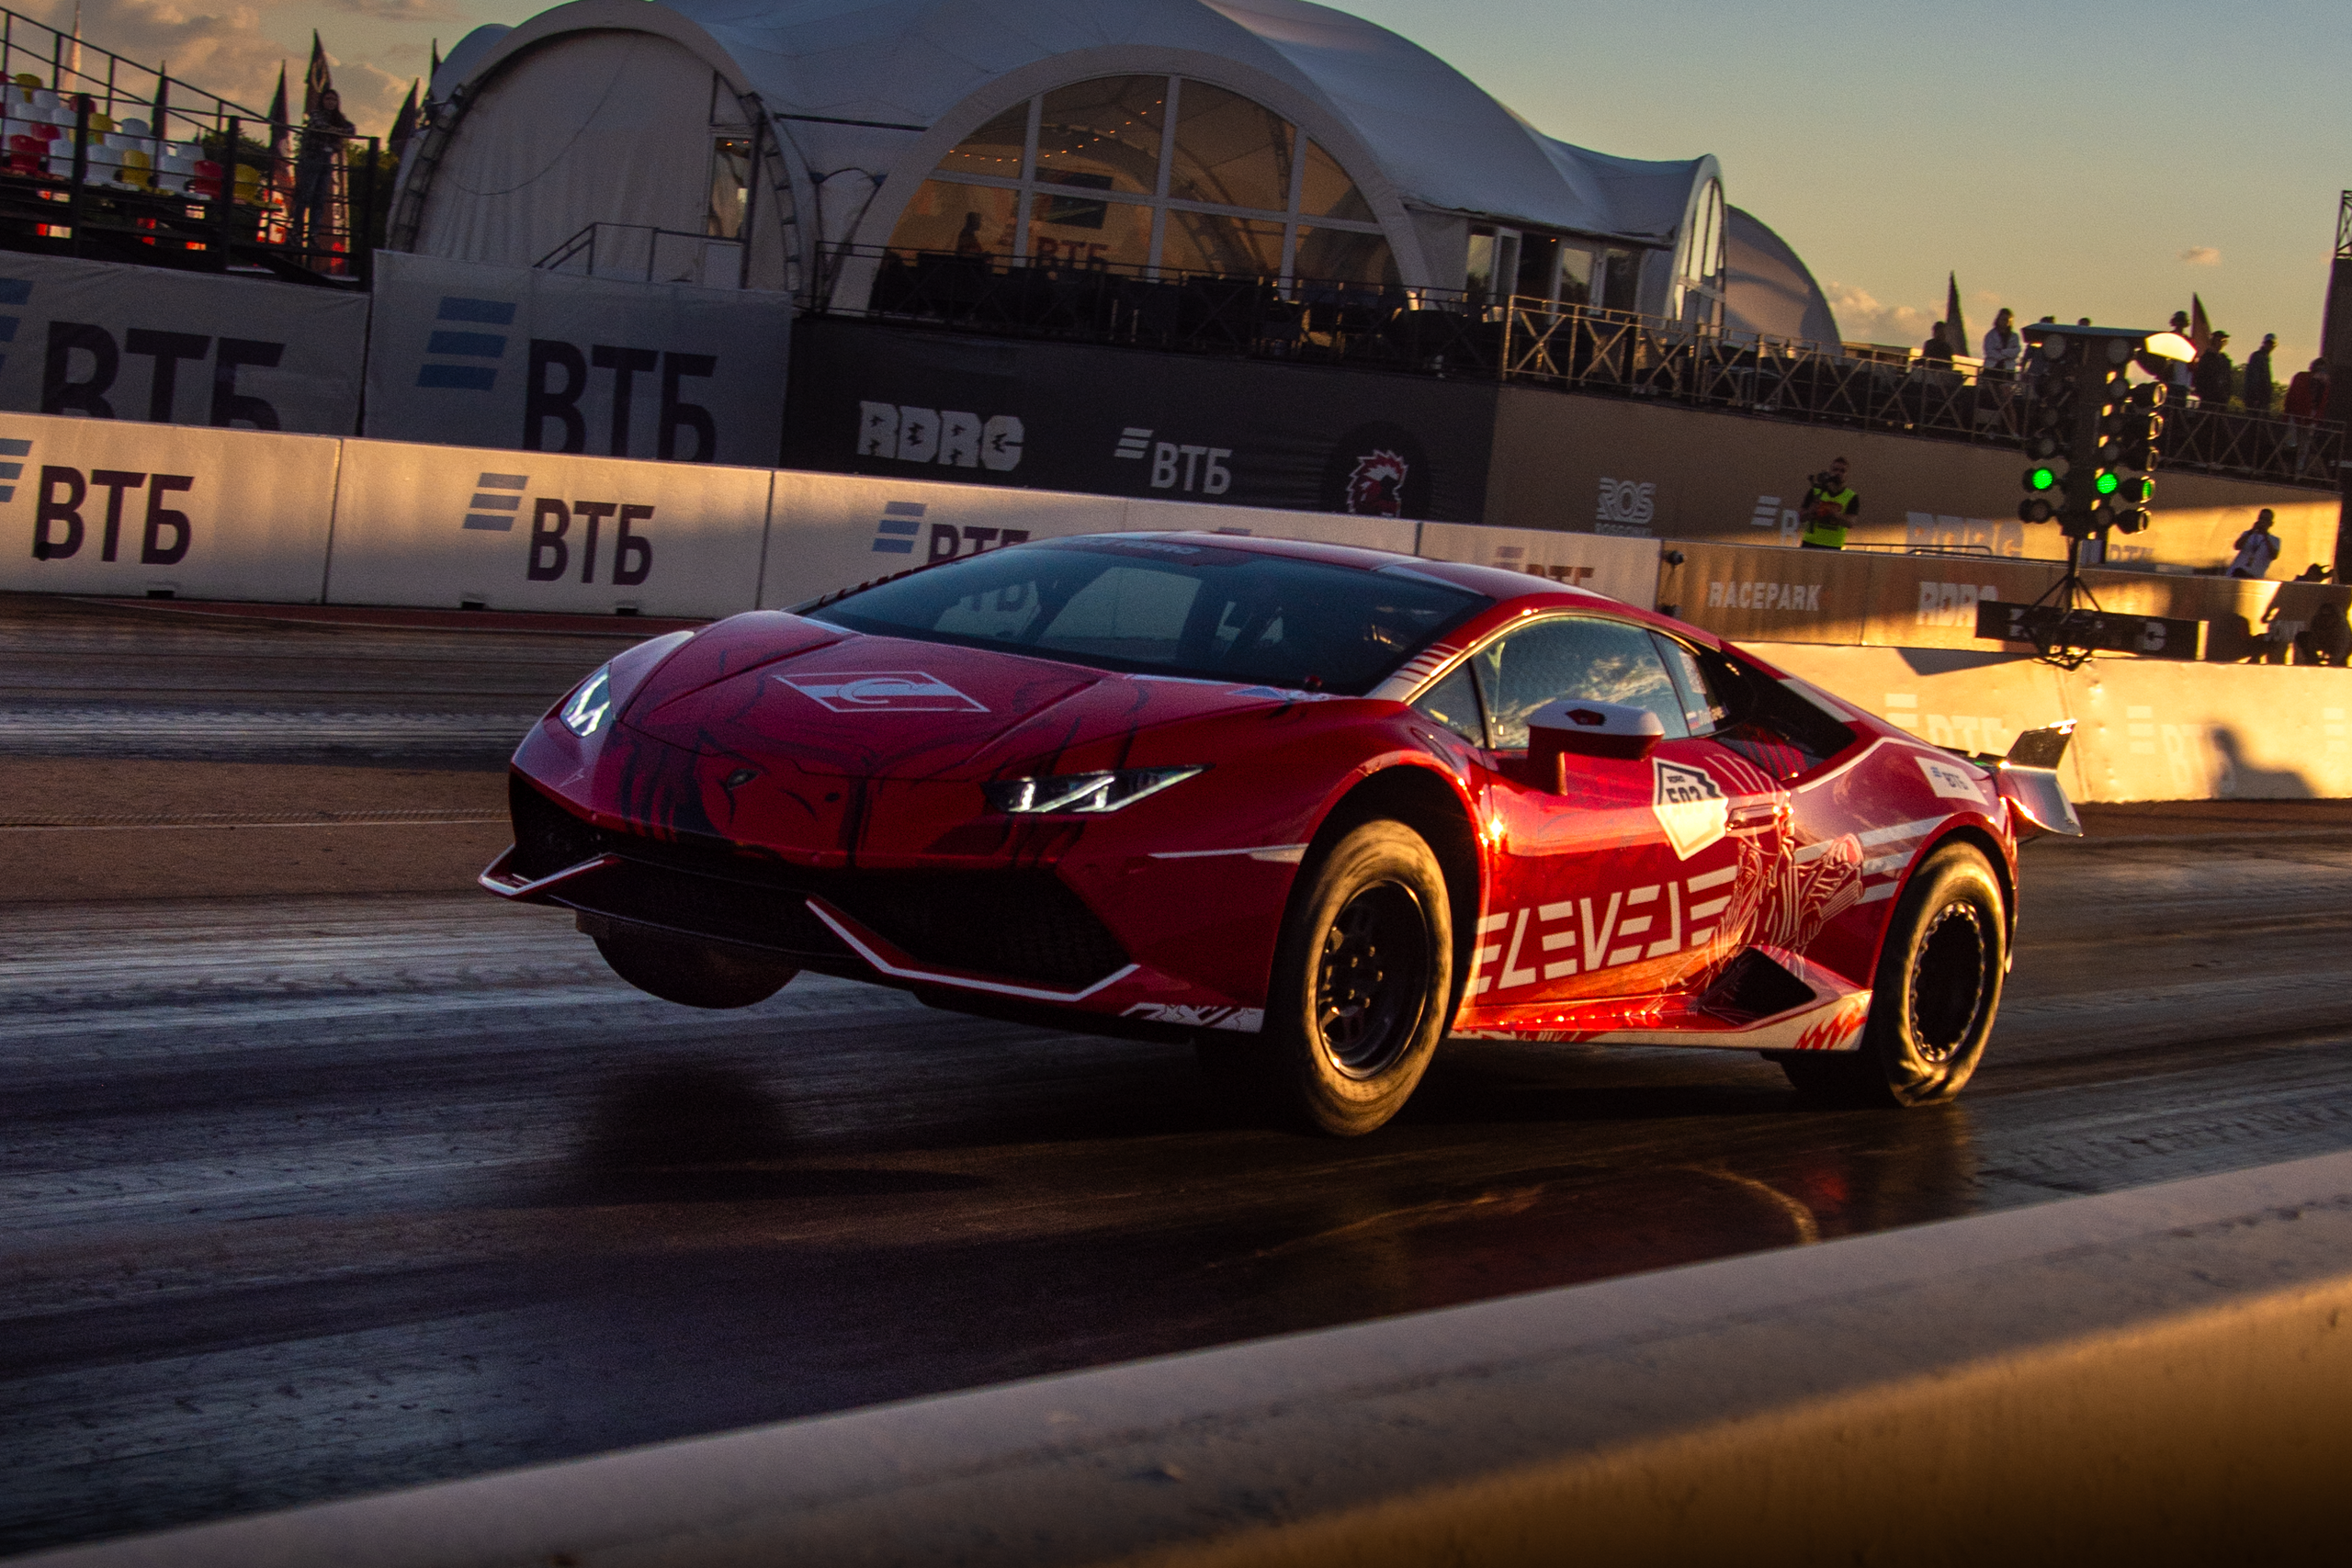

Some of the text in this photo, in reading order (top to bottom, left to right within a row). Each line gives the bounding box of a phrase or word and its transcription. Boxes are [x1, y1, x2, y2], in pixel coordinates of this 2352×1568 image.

[41, 320, 286, 431] ВТБ
[523, 337, 718, 463] ВТБ
[32, 464, 195, 566] ВТБ
[1149, 441, 1233, 495] ВТБ
[526, 497, 655, 586] ВТБ
[1708, 581, 1822, 612] RACEPARK
